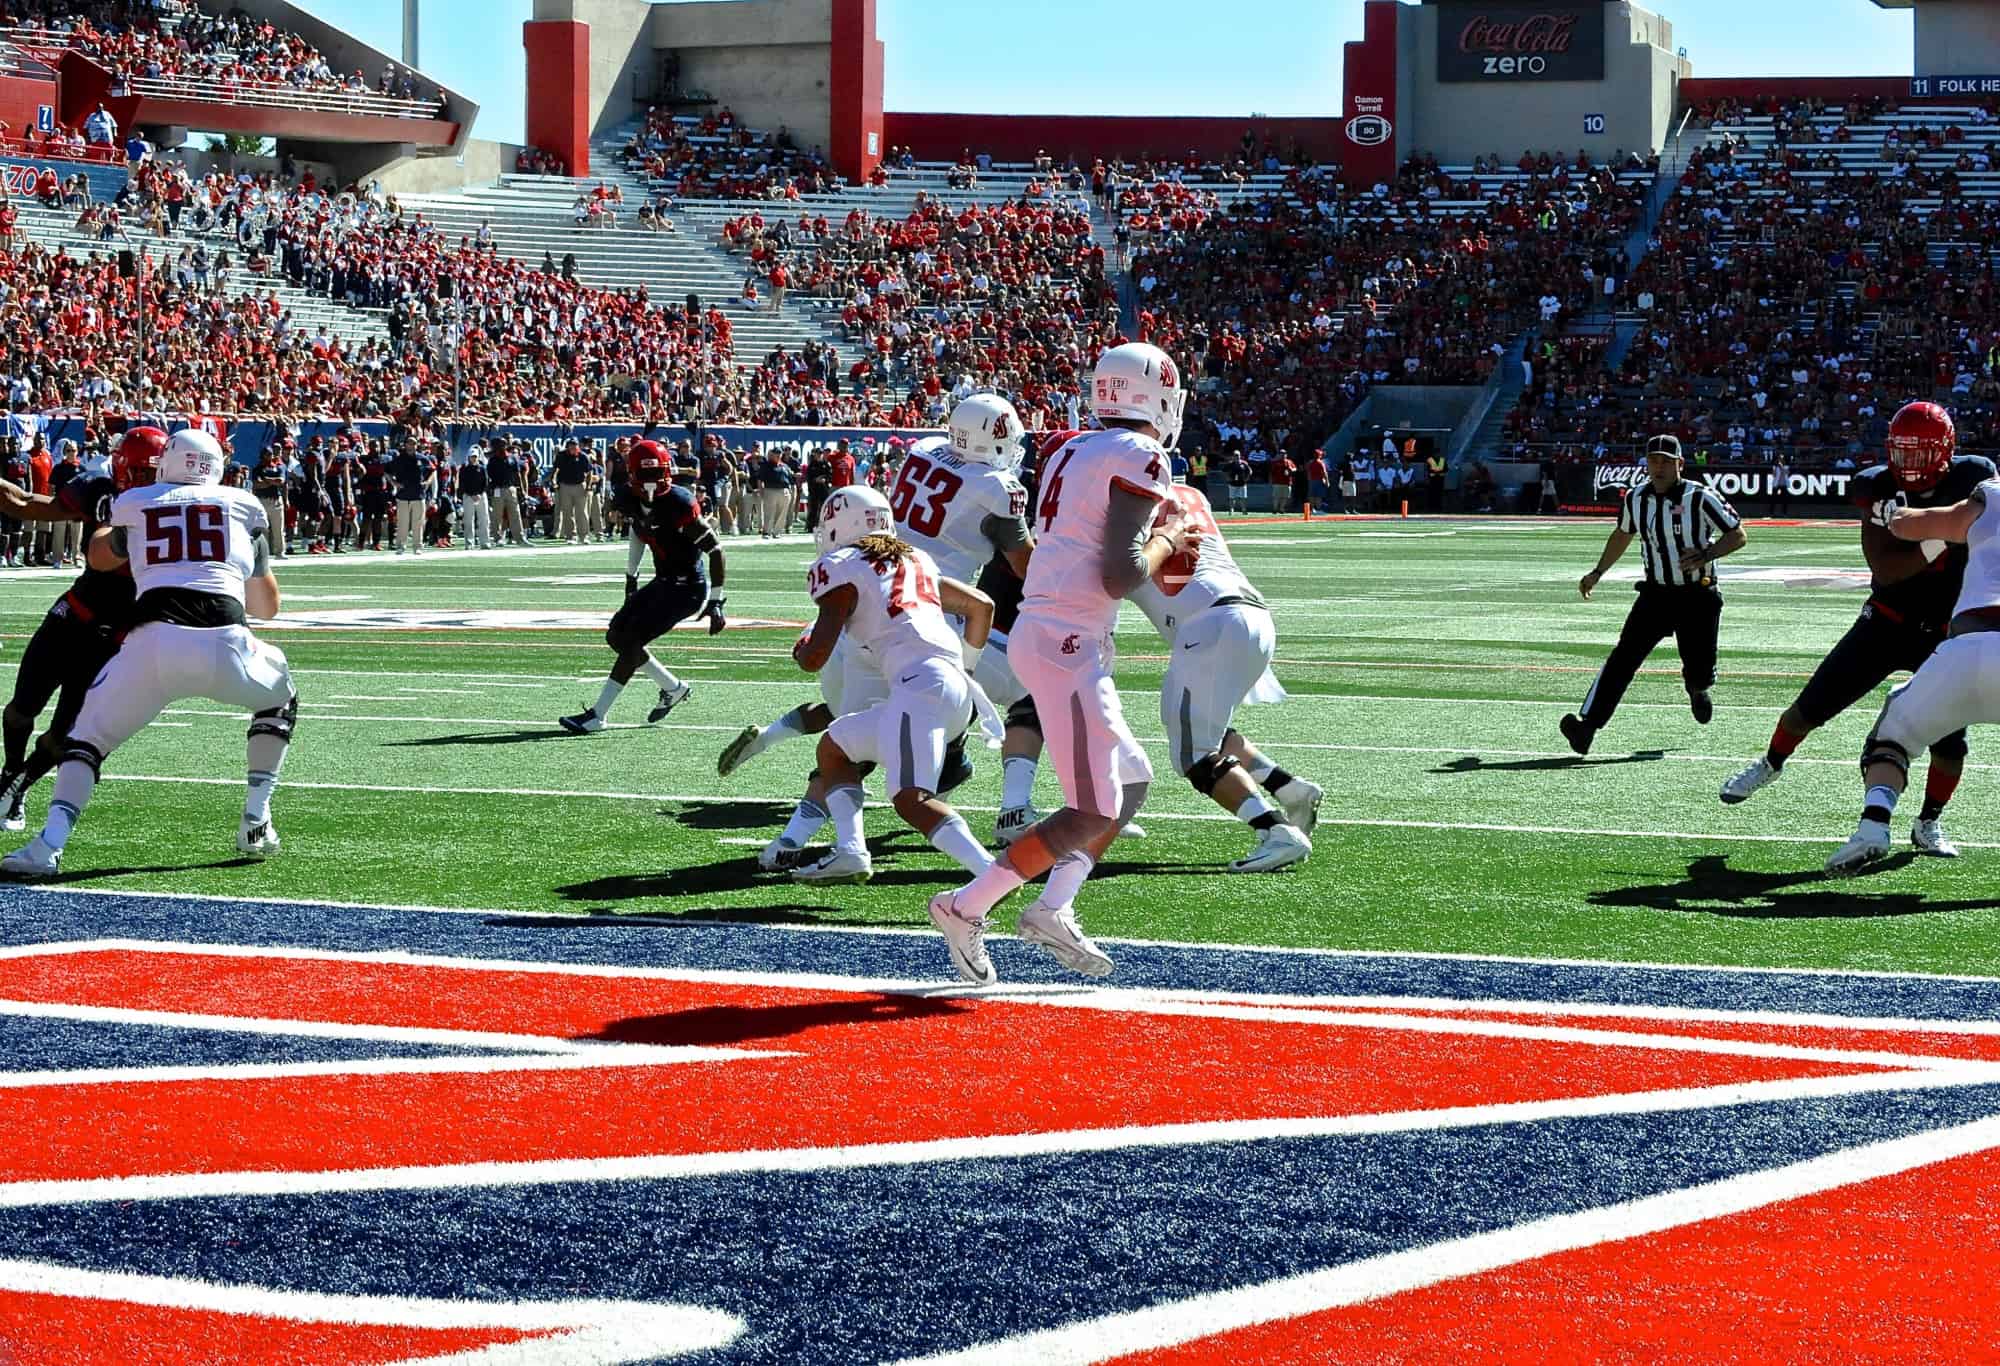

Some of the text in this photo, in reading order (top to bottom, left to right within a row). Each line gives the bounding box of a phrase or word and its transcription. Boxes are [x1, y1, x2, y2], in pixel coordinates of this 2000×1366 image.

[1459, 14, 1575, 53] Coca-Cola
[1483, 56, 1545, 74] zero
[1913, 80, 1928, 94] 11
[1939, 80, 2000, 92] FOLK HE
[1355, 95, 1384, 103] Damon
[41, 107, 50, 123] 7
[1584, 116, 1604, 132] 10
[1110, 390, 1118, 403] 4
[957, 437, 967, 449] 63
[199, 462, 211, 476] 56
[1144, 452, 1161, 481] 4
[1039, 448, 1076, 533] 4
[1702, 472, 1760, 495] YOU
[889, 453, 964, 538] 63
[880, 517, 890, 531] 24
[141, 504, 227, 565] 56
[807, 562, 830, 596] 24
[997, 809, 1025, 829] NIKE
